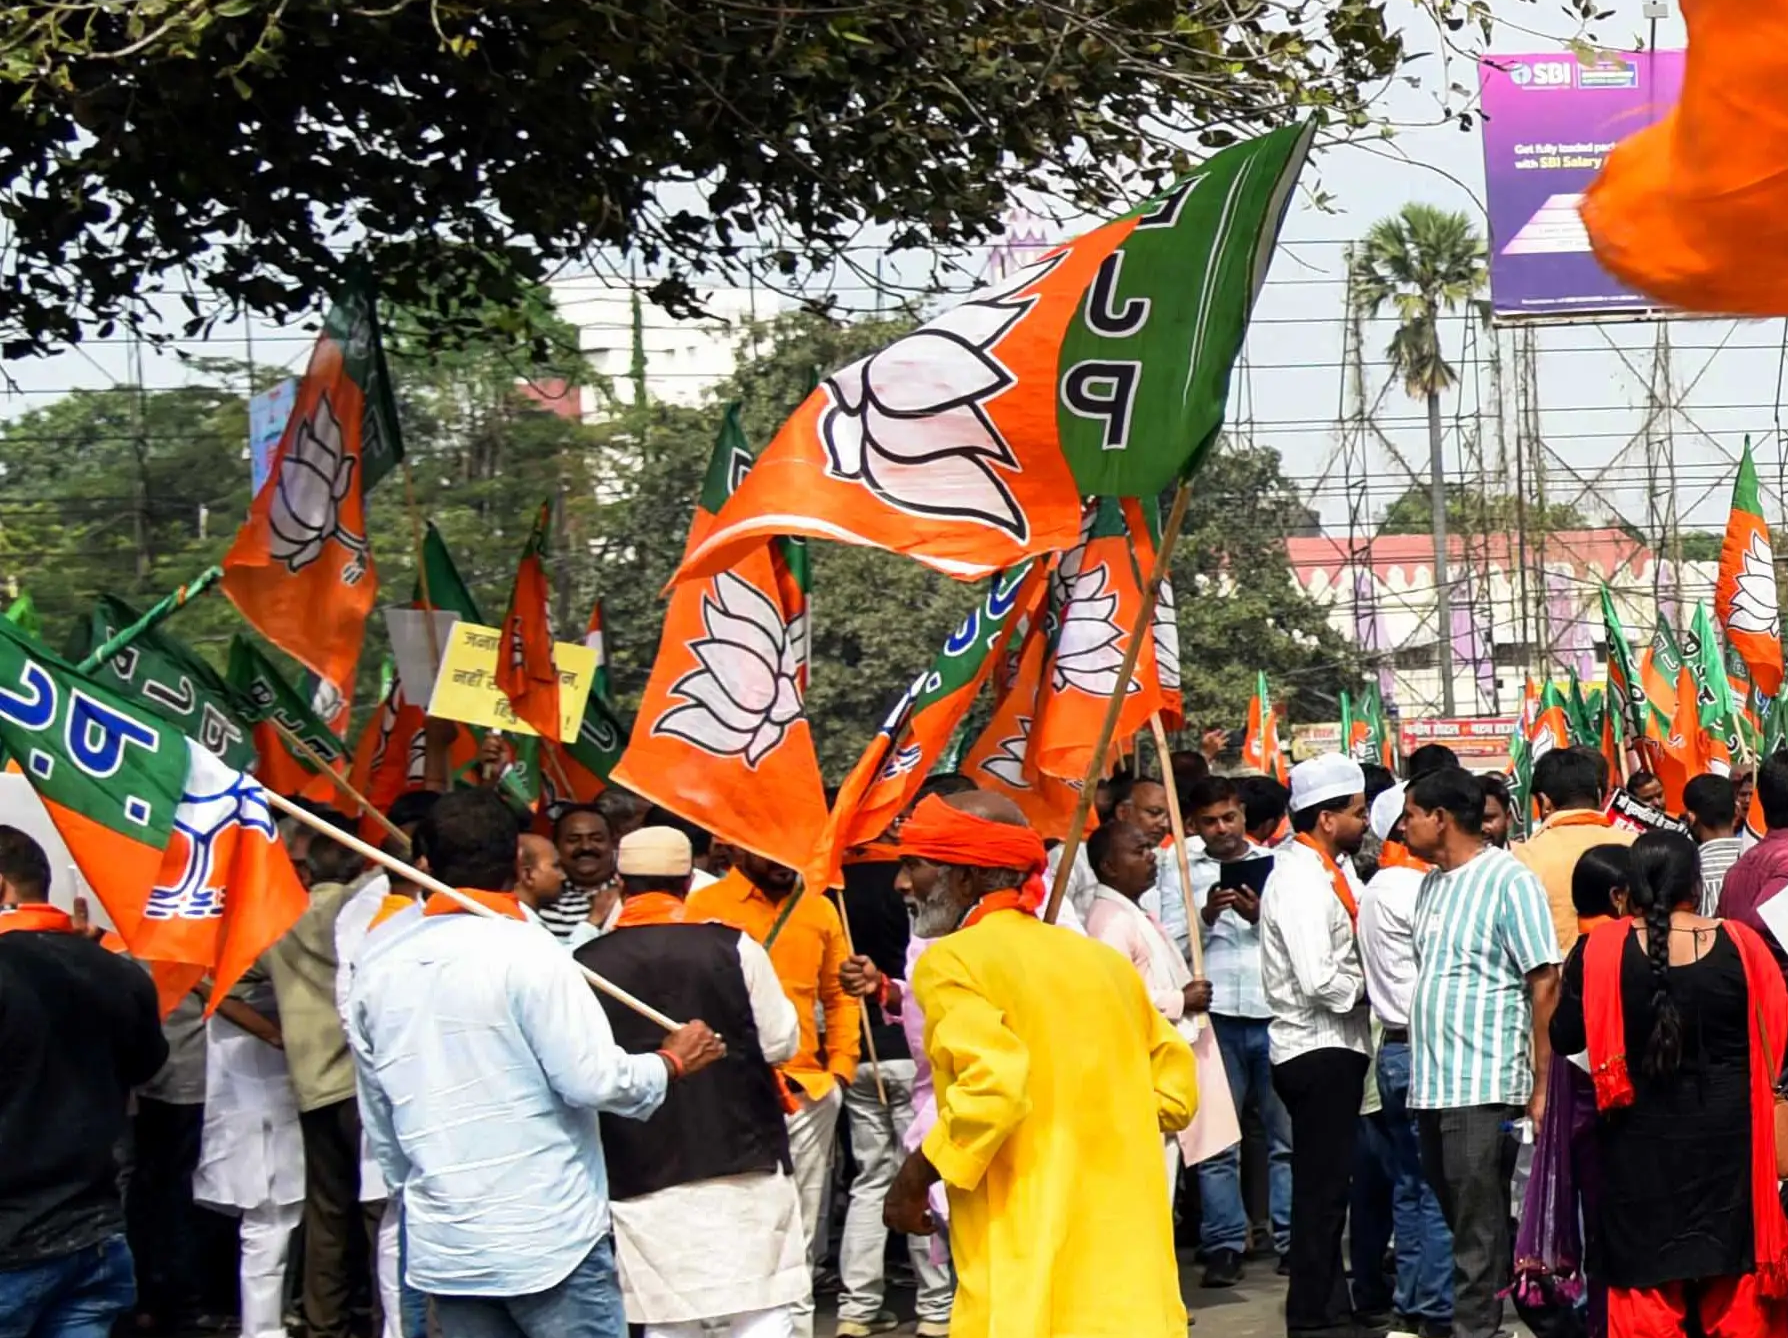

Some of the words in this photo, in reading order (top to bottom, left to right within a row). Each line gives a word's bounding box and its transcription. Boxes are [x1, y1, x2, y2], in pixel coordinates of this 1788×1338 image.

[1532, 62, 1571, 85] SBI
[1513, 144, 1535, 155] Get
[1539, 156, 1561, 169] SBI
[1562, 155, 1603, 170] Salary
